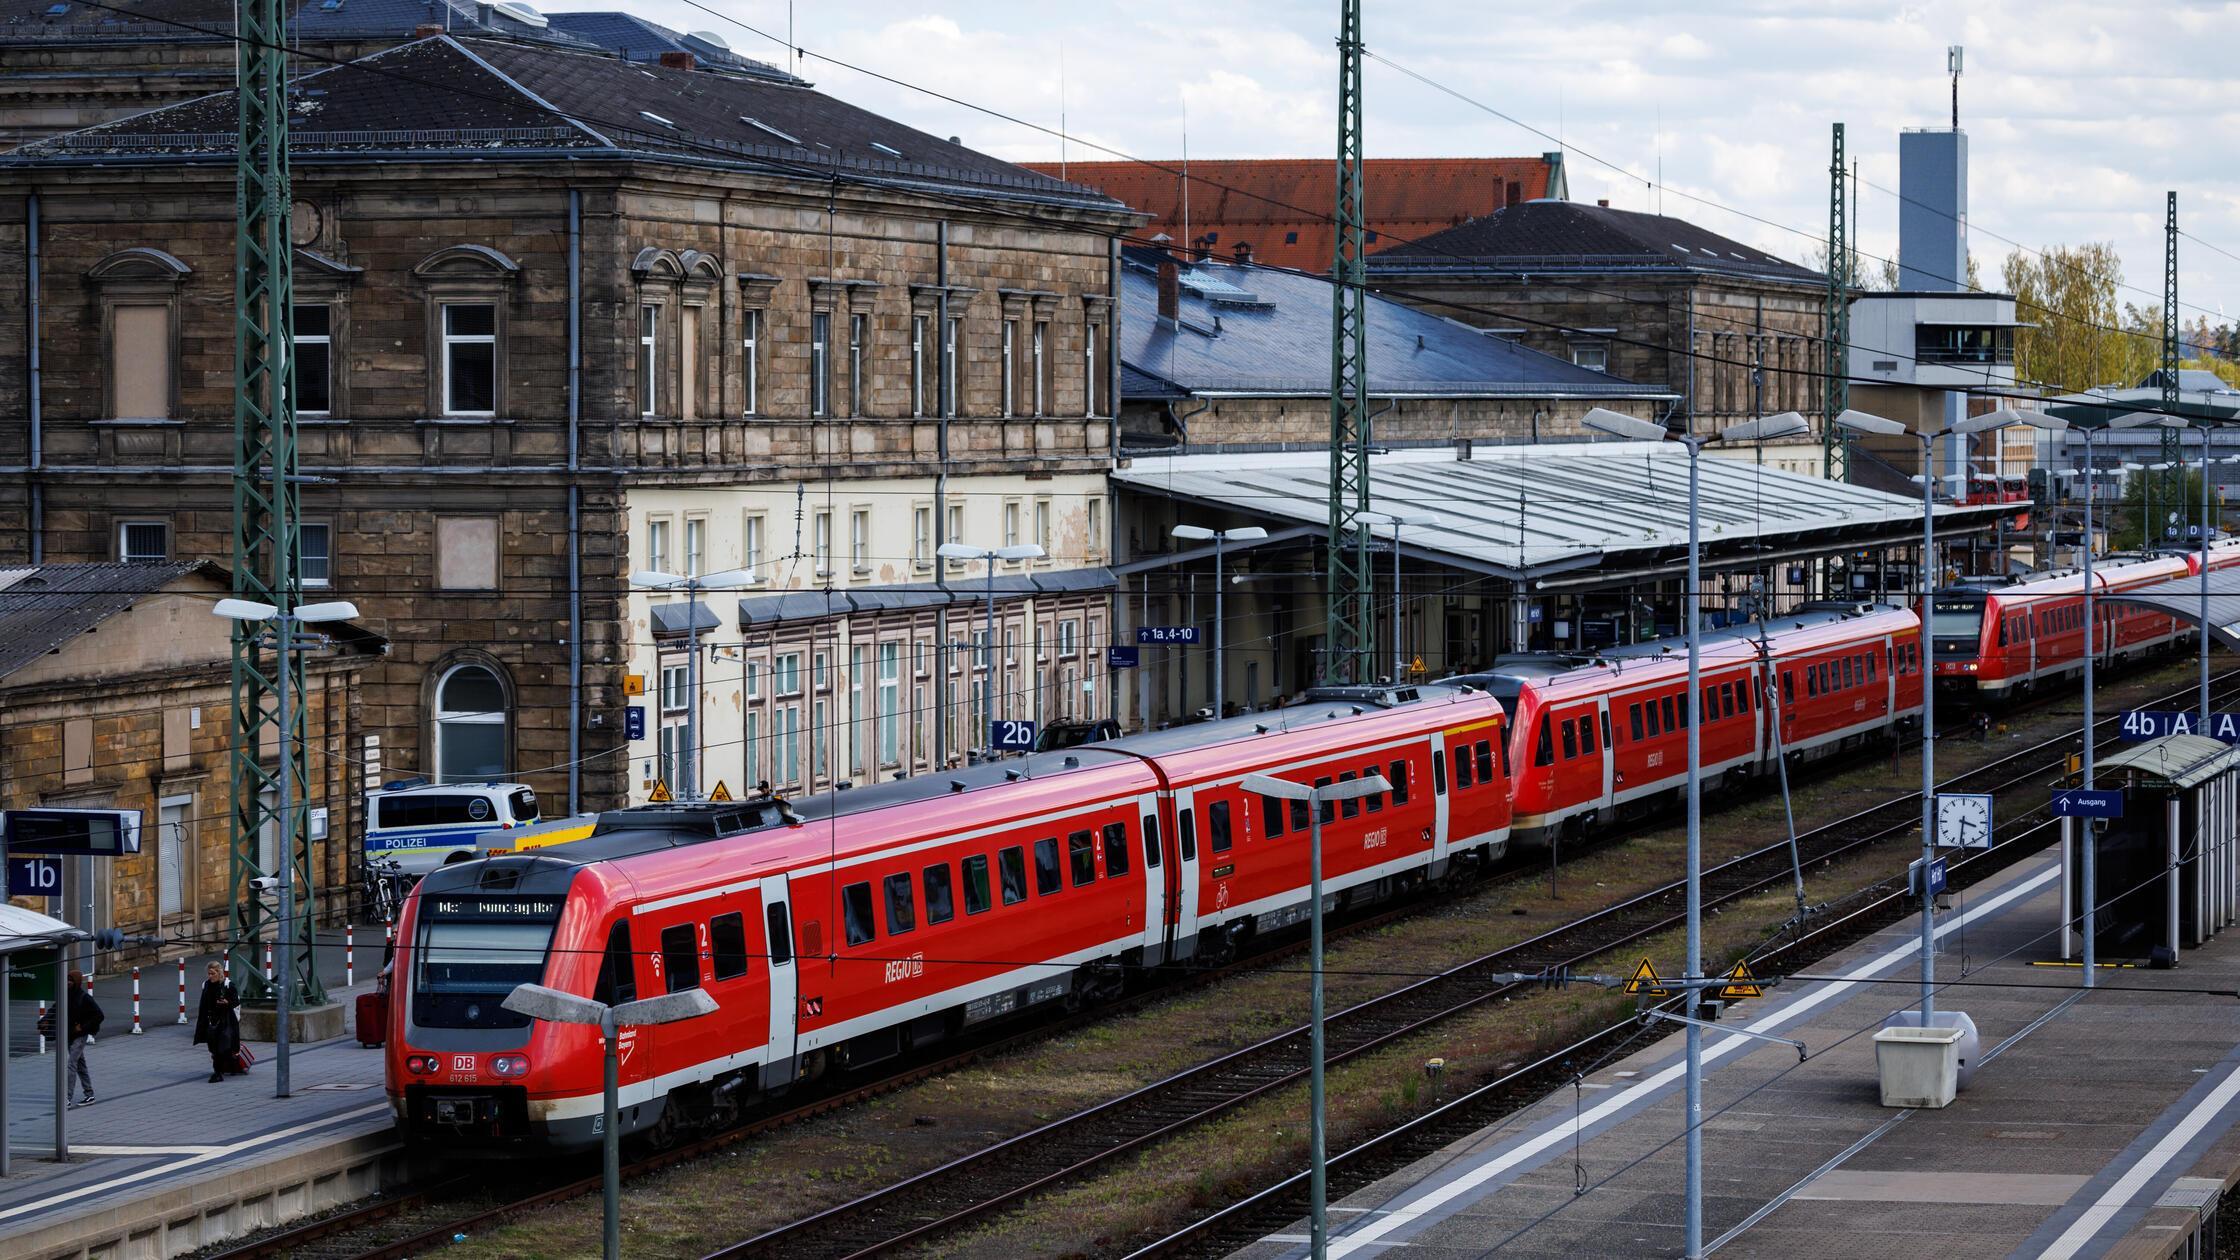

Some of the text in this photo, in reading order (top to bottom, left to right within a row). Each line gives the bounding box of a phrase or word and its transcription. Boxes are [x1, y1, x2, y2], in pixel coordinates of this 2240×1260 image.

[1002, 721, 1032, 745] 2b
[2123, 712, 2237, 737] 4b A A
[2077, 798, 2106, 807] Ausgang
[385, 838, 427, 849] POLIZEI
[1094, 830, 1101, 851] 2
[1364, 831, 1379, 850] REGIO
[24, 860, 56, 888] 1b
[699, 923, 707, 947] 2
[885, 956, 911, 983] REGIO
[455, 1057, 474, 1069] DB
[450, 1074, 477, 1083] 612 615
